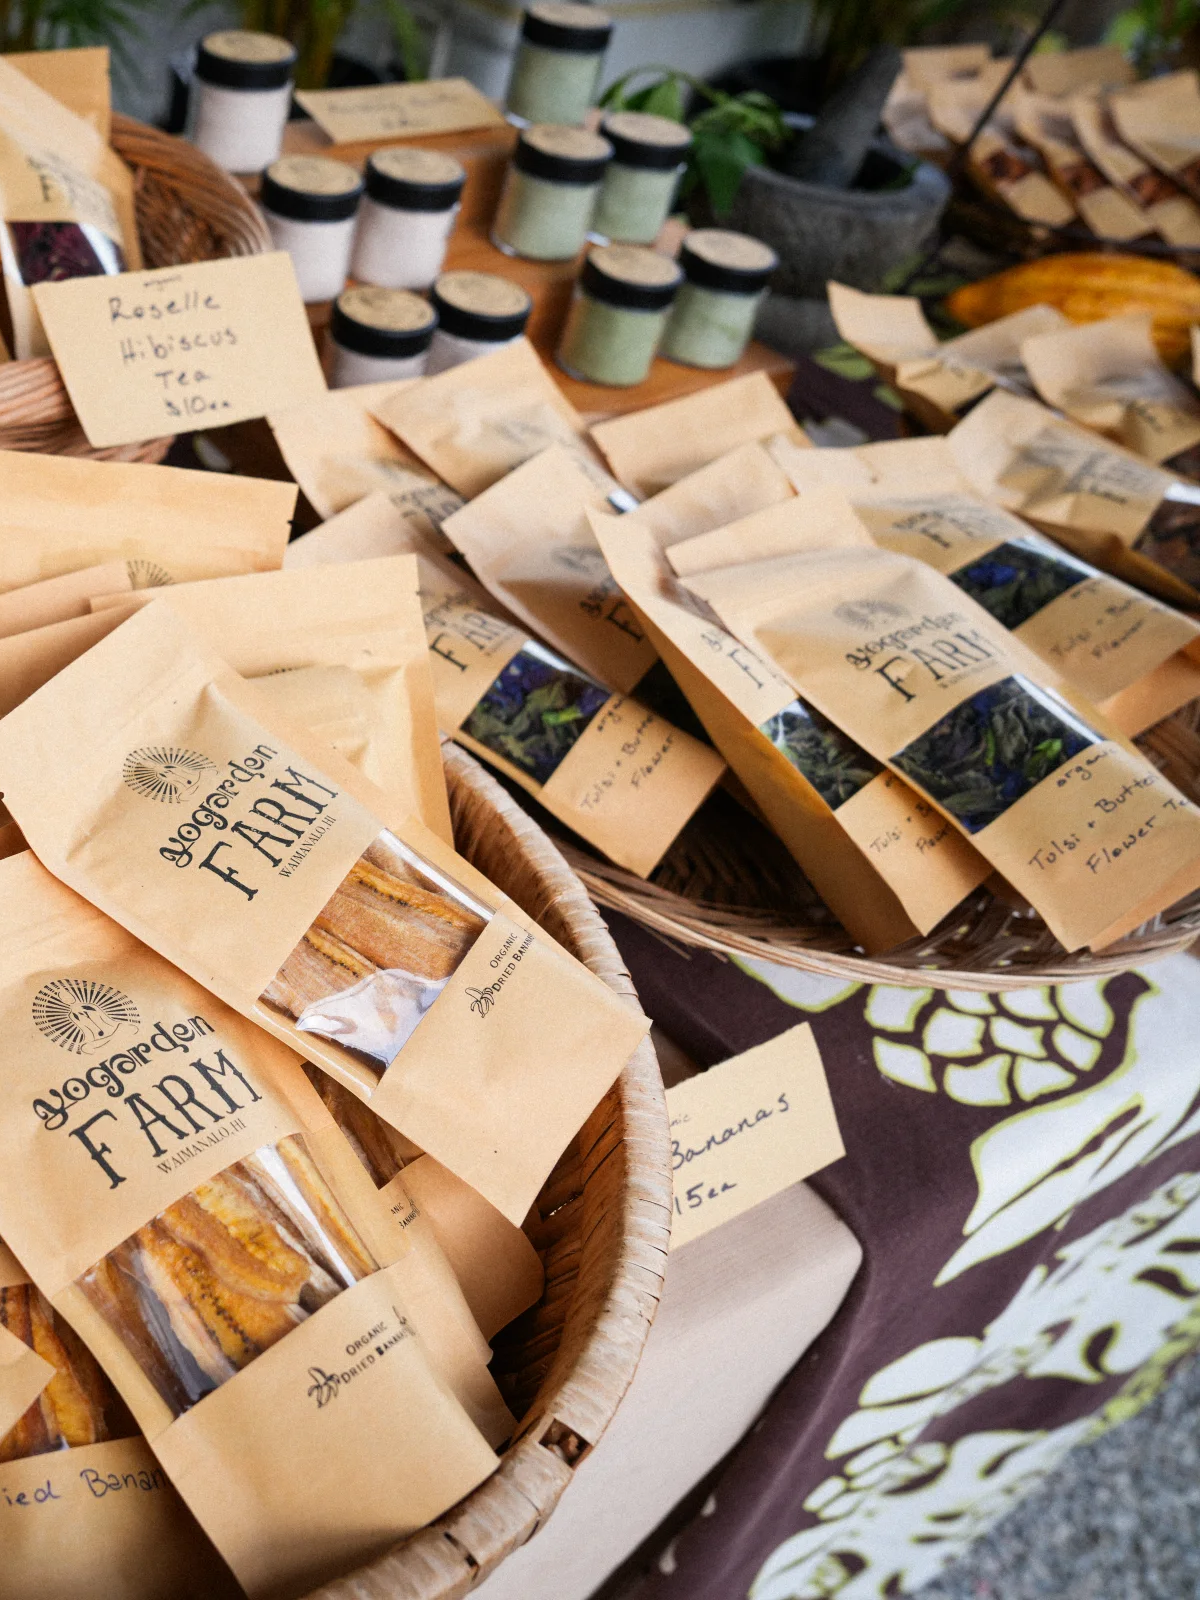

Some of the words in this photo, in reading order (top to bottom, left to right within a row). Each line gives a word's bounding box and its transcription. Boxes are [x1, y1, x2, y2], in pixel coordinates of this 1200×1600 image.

[108, 289, 222, 325] Roselle
[119, 327, 239, 367] Hibiscus
[154, 368, 213, 390] Tea
[158, 743, 279, 868] yogarden
[199, 765, 340, 902] FARM
[1028, 832, 1081, 871] Tulsi
[1085, 814, 1157, 875] Flower
[489, 932, 518, 969] ORGANIC
[491, 962, 516, 992] DRIED
[32, 1013, 216, 1132] yogarden
[68, 1047, 263, 1190] FARM
[670, 1092, 791, 1171] Bananas
[345, 1321, 388, 1356] ORGANIC
[340, 1354, 376, 1384] DRIED
[79, 1467, 167, 1498] Banan
